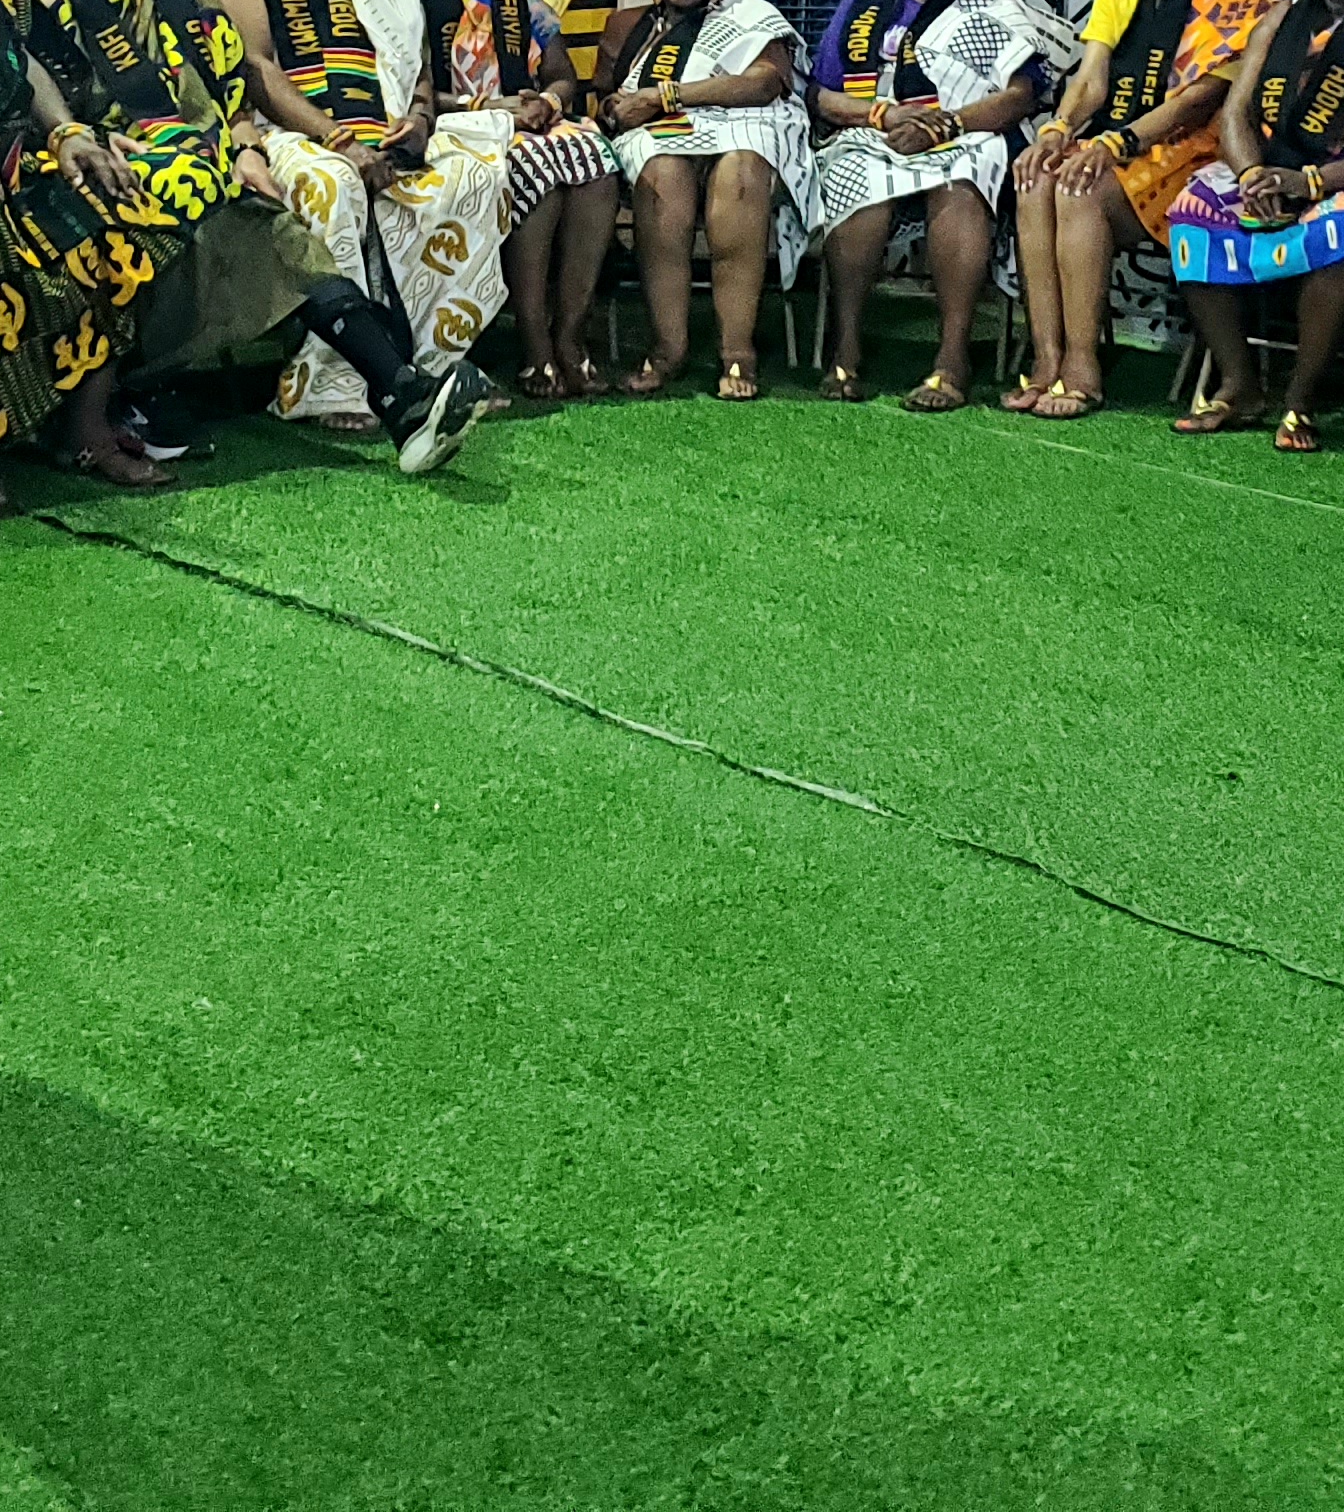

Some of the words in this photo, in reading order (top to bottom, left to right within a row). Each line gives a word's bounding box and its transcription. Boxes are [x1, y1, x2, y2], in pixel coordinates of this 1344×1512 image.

[96, 23, 140, 72] KOFI
[1110, 76, 1136, 120] AFIA
[1261, 77, 1287, 123] AFIA
